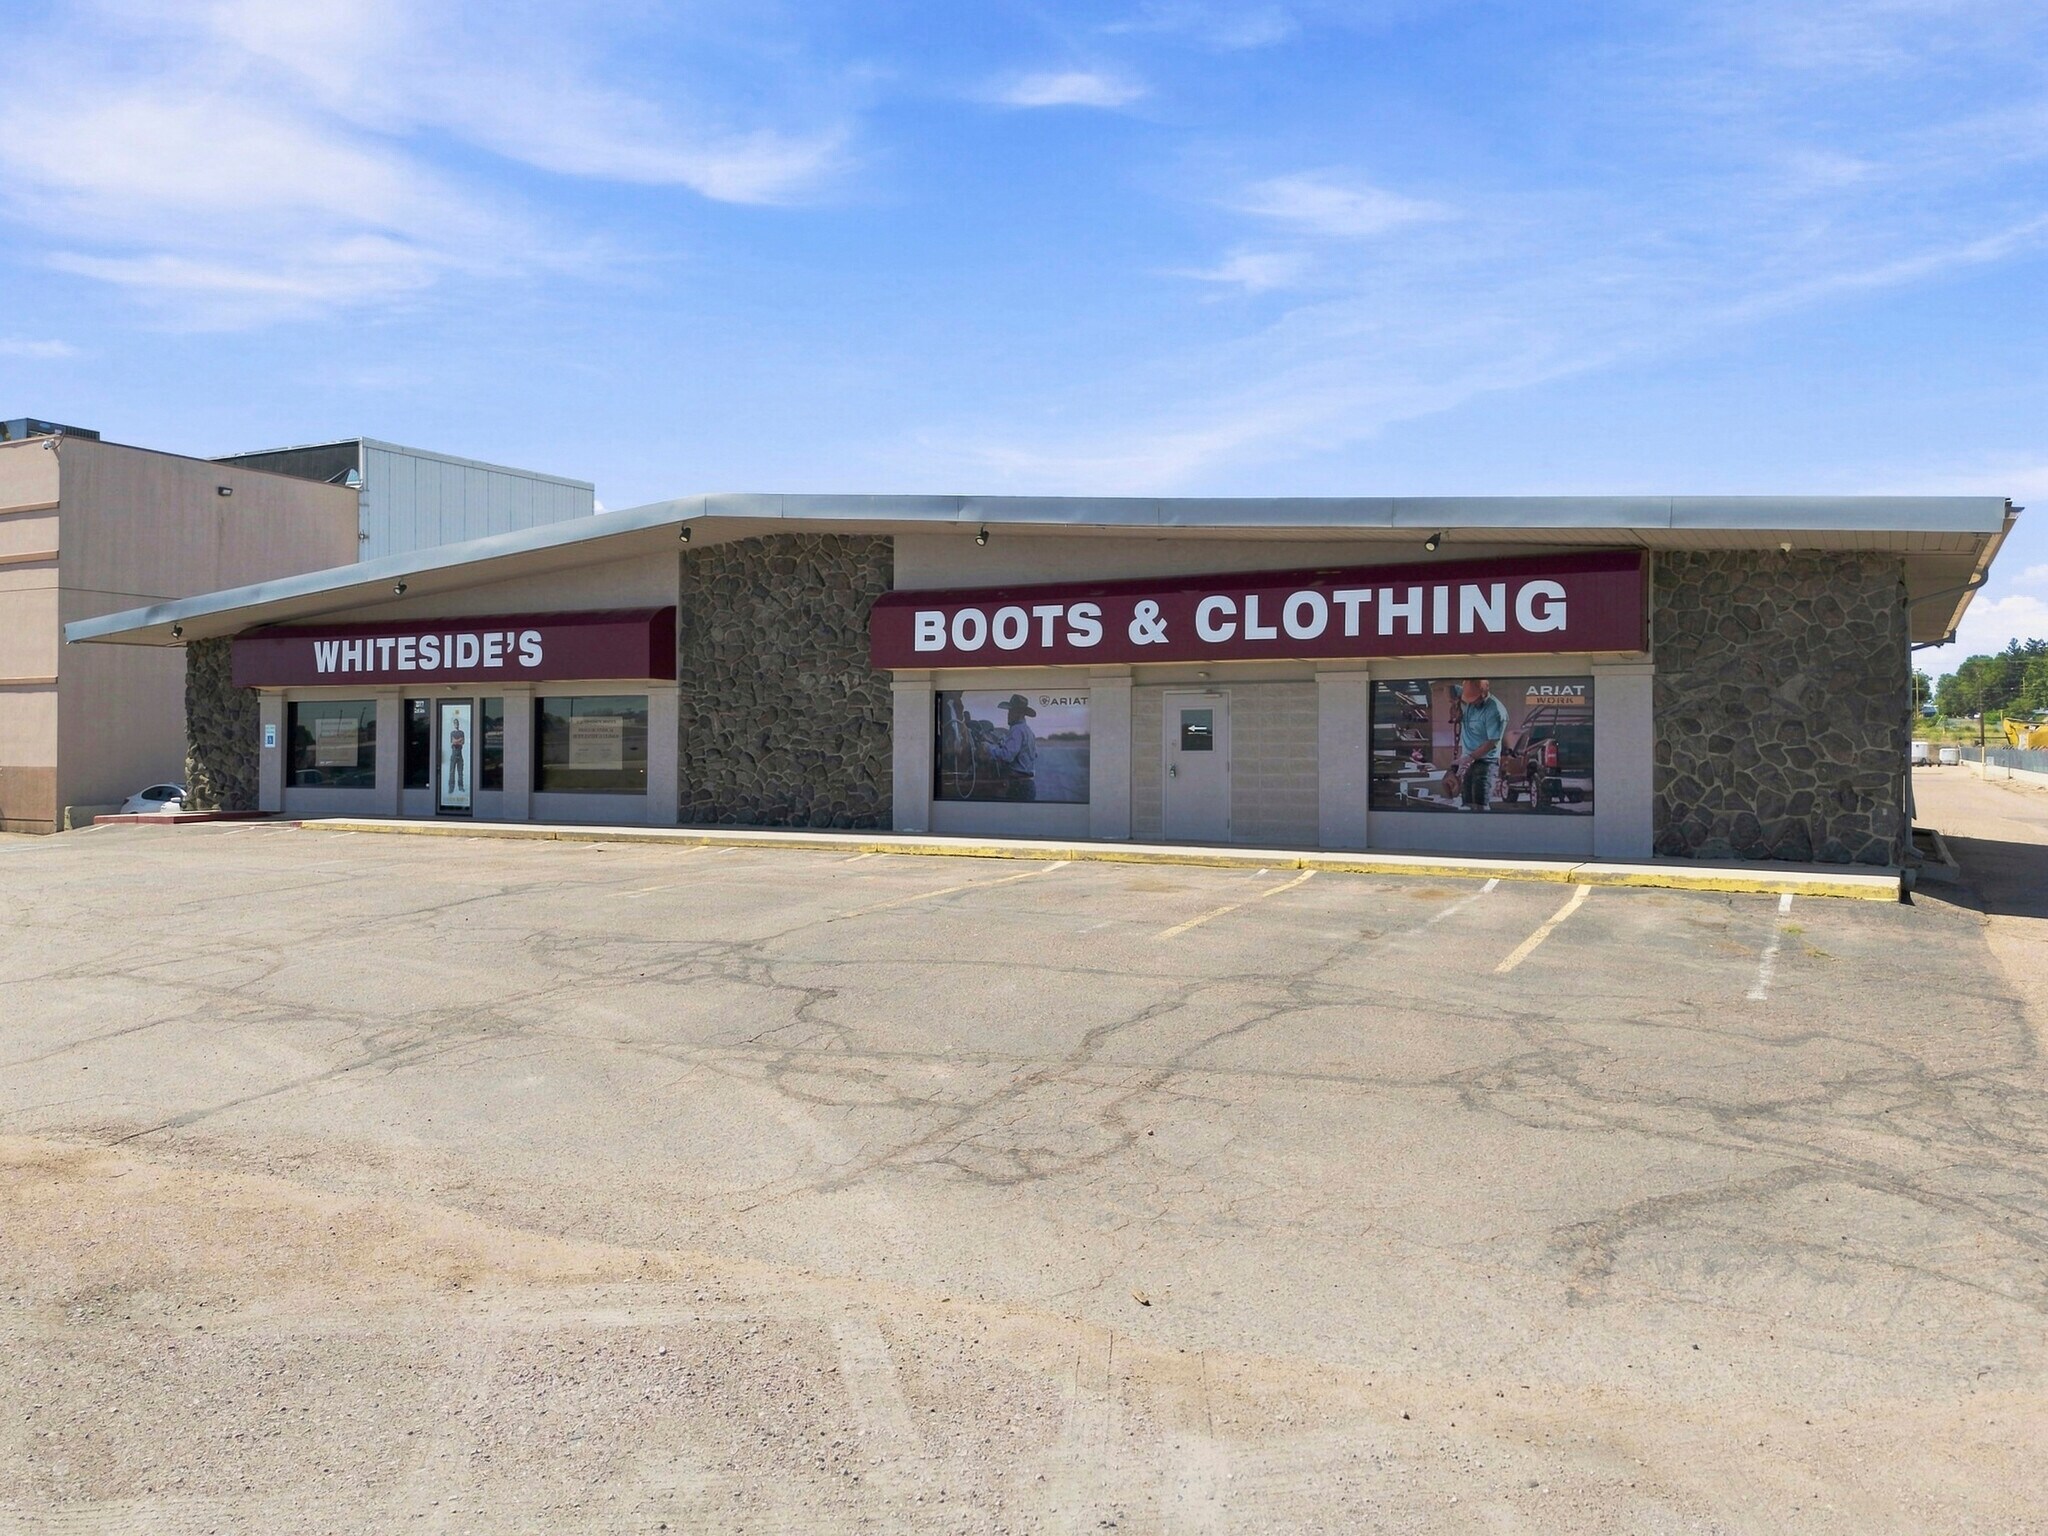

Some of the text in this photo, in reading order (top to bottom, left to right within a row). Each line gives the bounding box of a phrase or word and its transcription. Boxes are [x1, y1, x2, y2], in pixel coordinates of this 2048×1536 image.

[914, 580, 1567, 652] BOOTS & CLOTHING
[313, 630, 543, 673] WHITESIDE'S
[1050, 697, 1089, 705] ARIAT
[1525, 685, 1585, 695] ARIAT
